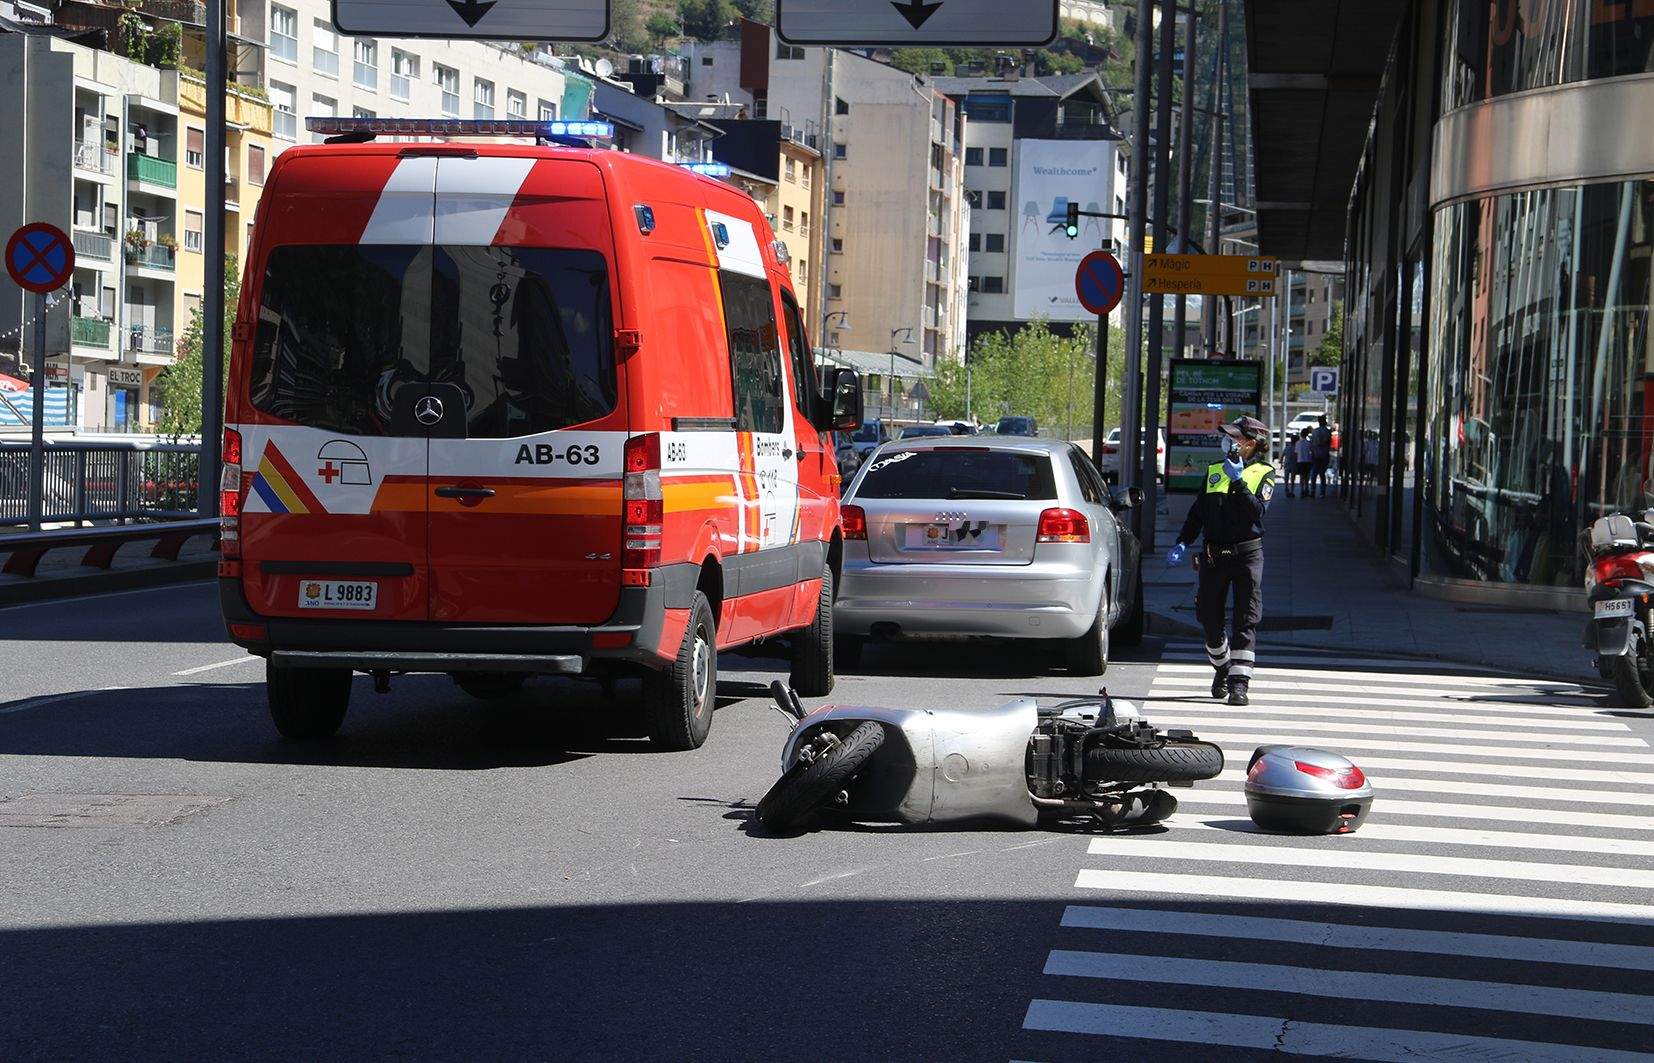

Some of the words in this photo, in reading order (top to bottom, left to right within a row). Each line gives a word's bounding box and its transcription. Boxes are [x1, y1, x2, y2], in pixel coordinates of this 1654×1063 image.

[1249, 261, 1257, 270] P
[1263, 262, 1272, 270] H
[1158, 279, 1202, 290] Hesperia
[1248, 282, 1256, 290] P
[1262, 282, 1270, 290] H
[109, 370, 119, 381] EL
[120, 371, 141, 384] TROC
[1316, 372, 1333, 390] P
[514, 443, 600, 466] AB-63
[666, 442, 686, 462] AB-63
[756, 436, 780, 457] Bombers
[324, 584, 333, 601] L
[336, 584, 373, 602] 9883
